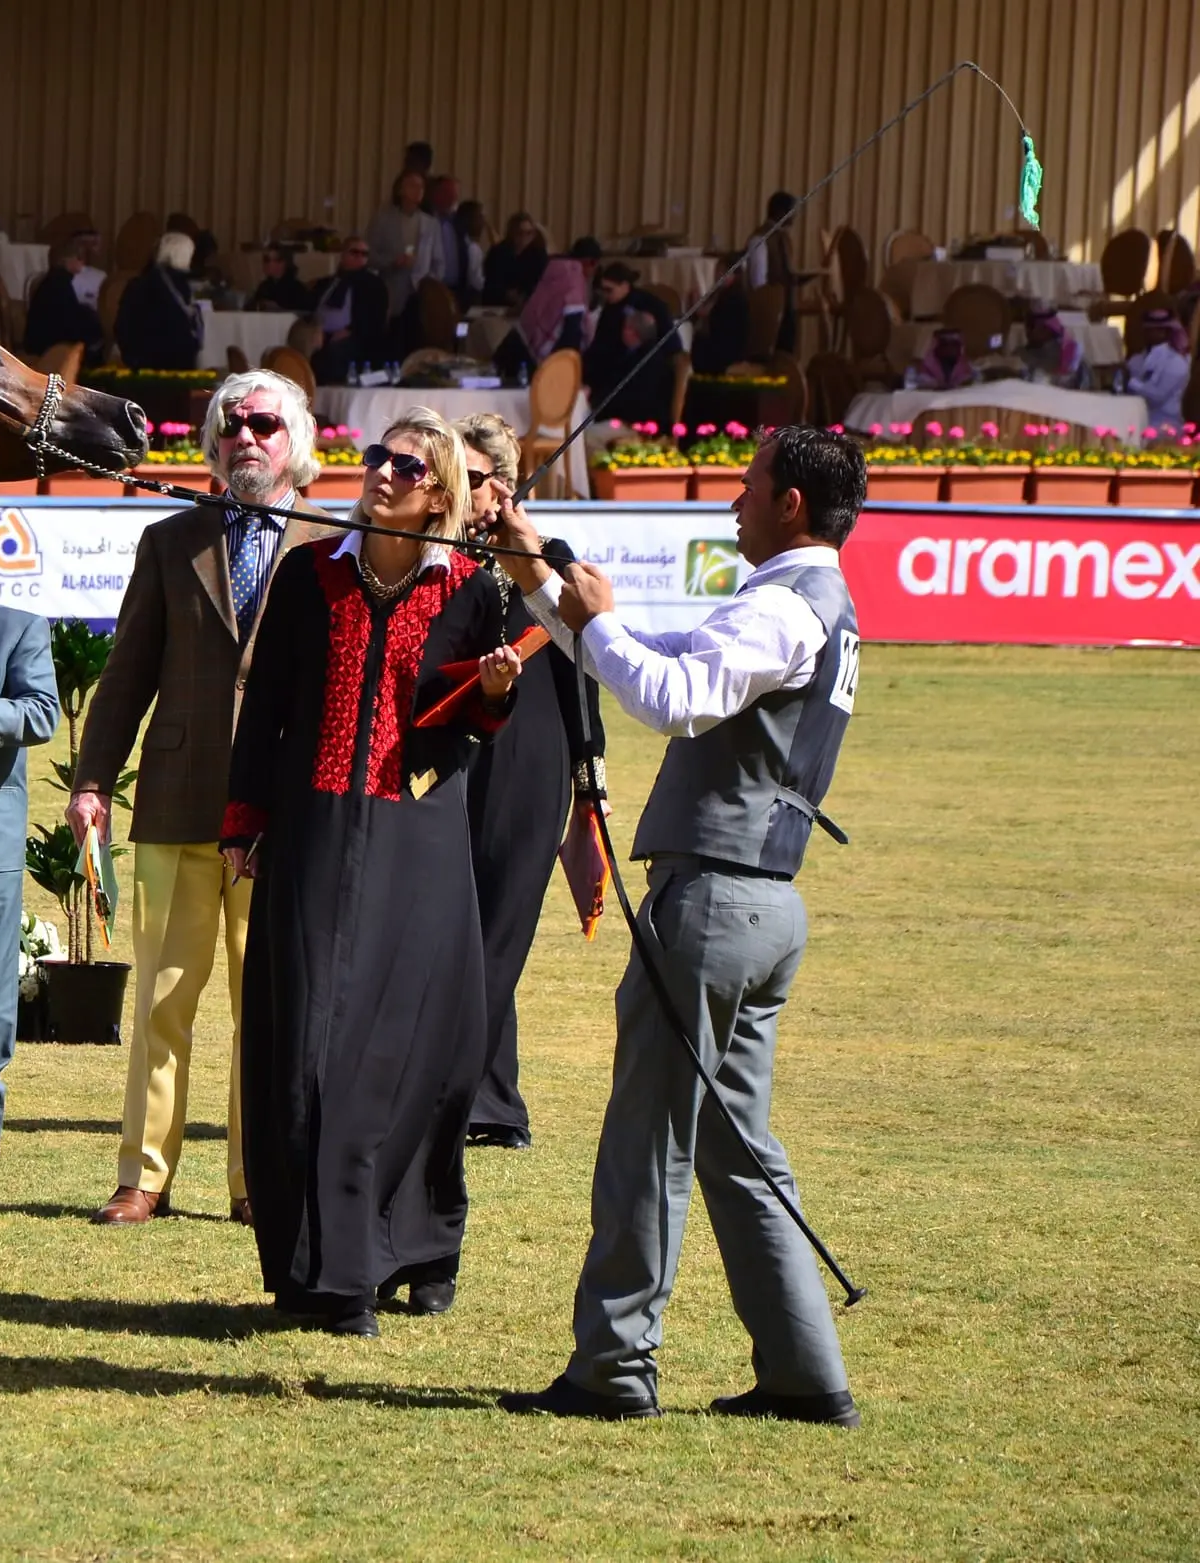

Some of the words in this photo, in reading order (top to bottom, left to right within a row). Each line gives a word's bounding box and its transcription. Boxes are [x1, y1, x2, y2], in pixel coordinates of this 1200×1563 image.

[621, 546, 676, 568] مؤسسة
[898, 537, 1200, 599] aramex
[62, 574, 124, 590] AL-RASHID
[609, 575, 643, 590] DING
